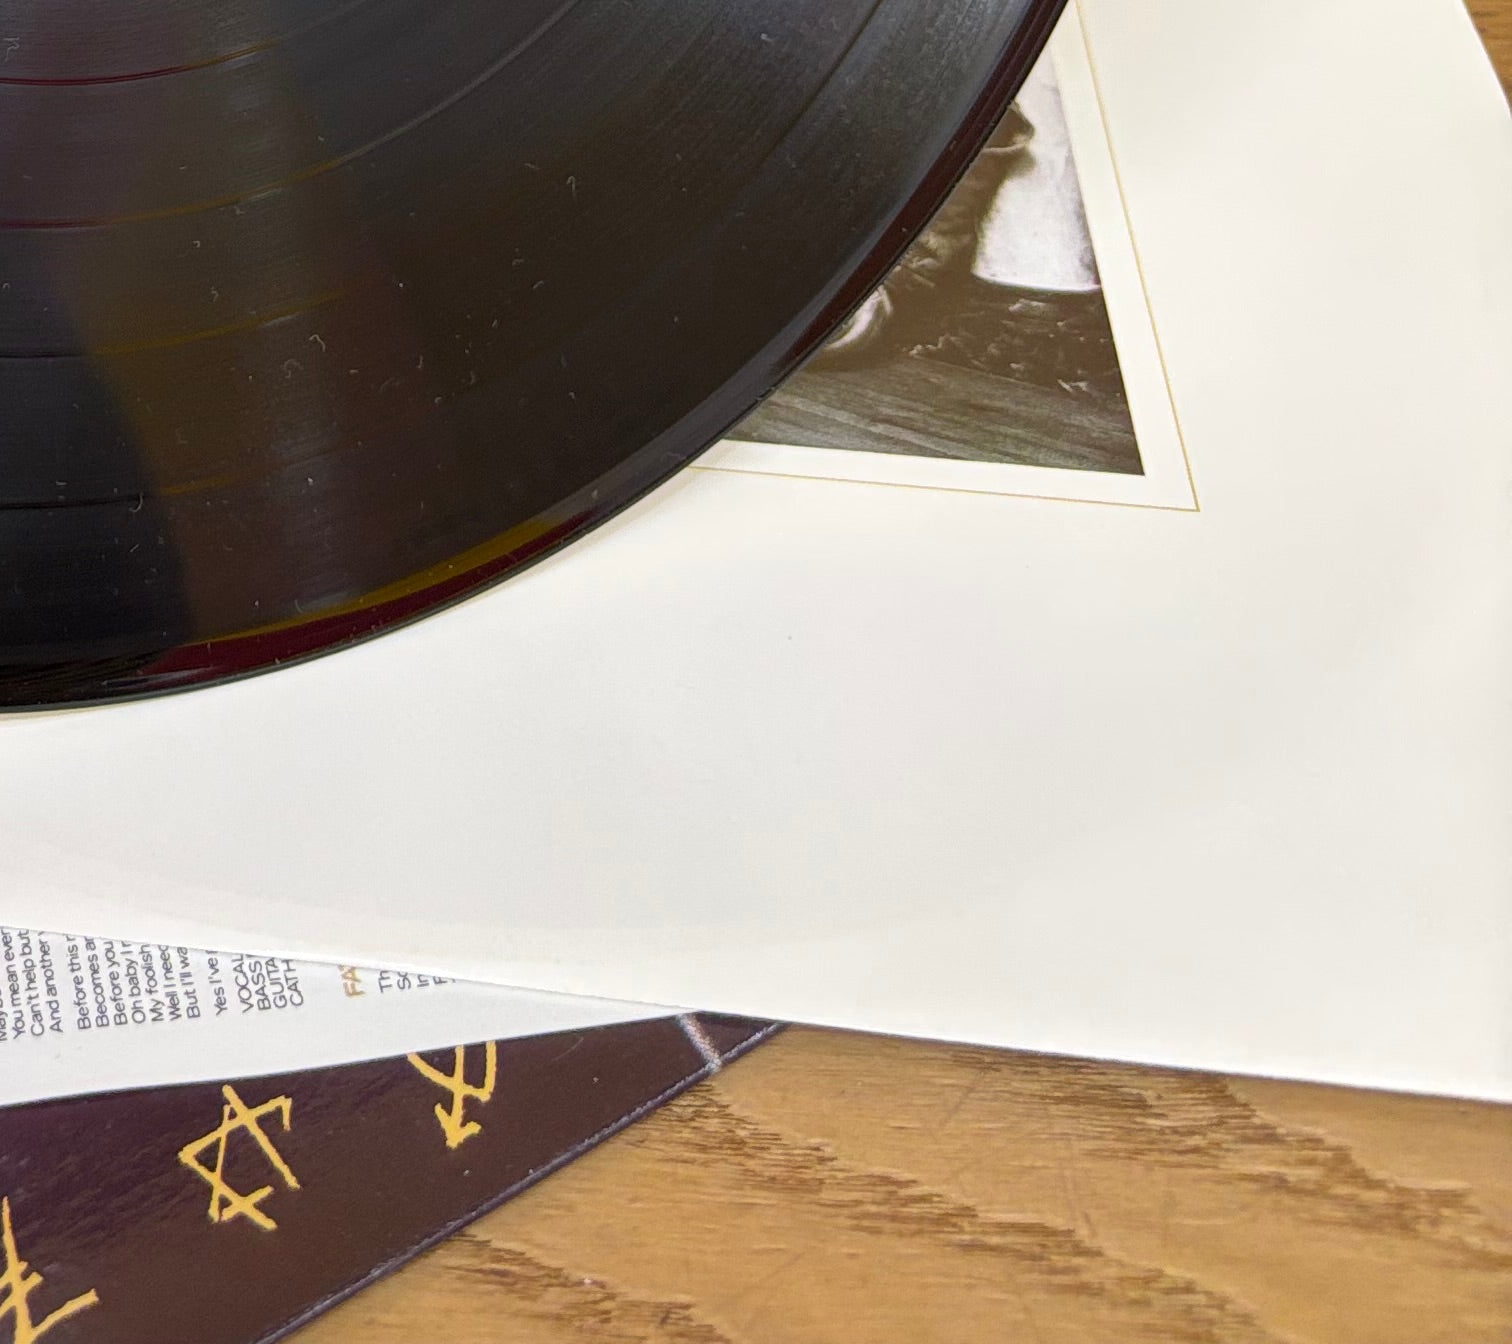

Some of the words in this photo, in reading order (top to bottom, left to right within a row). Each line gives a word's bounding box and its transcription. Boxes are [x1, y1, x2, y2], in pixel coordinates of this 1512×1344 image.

[17, 929, 32, 956] but
[68, 944, 81, 973] this
[22, 958, 38, 992] help
[39, 939, 58, 996] another
[124, 958, 141, 997] baby
[138, 944, 158, 995] foolish
[179, 972, 194, 986] I'll
[208, 957, 222, 984] I've
[6, 964, 21, 1007] mean
[87, 954, 110, 1028] Becomes
[108, 971, 128, 1026] Before
[214, 986, 228, 1016] Yes
[248, 960, 272, 1011] BASS
[26, 993, 45, 1037] Can't
[46, 1000, 63, 1032] And
[73, 975, 92, 1030] Before
[131, 1000, 146, 1024] Oh
[149, 998, 165, 1022] My
[165, 991, 182, 1021] Well
[184, 988, 201, 1019] But
[12, 1010, 26, 1040] You
